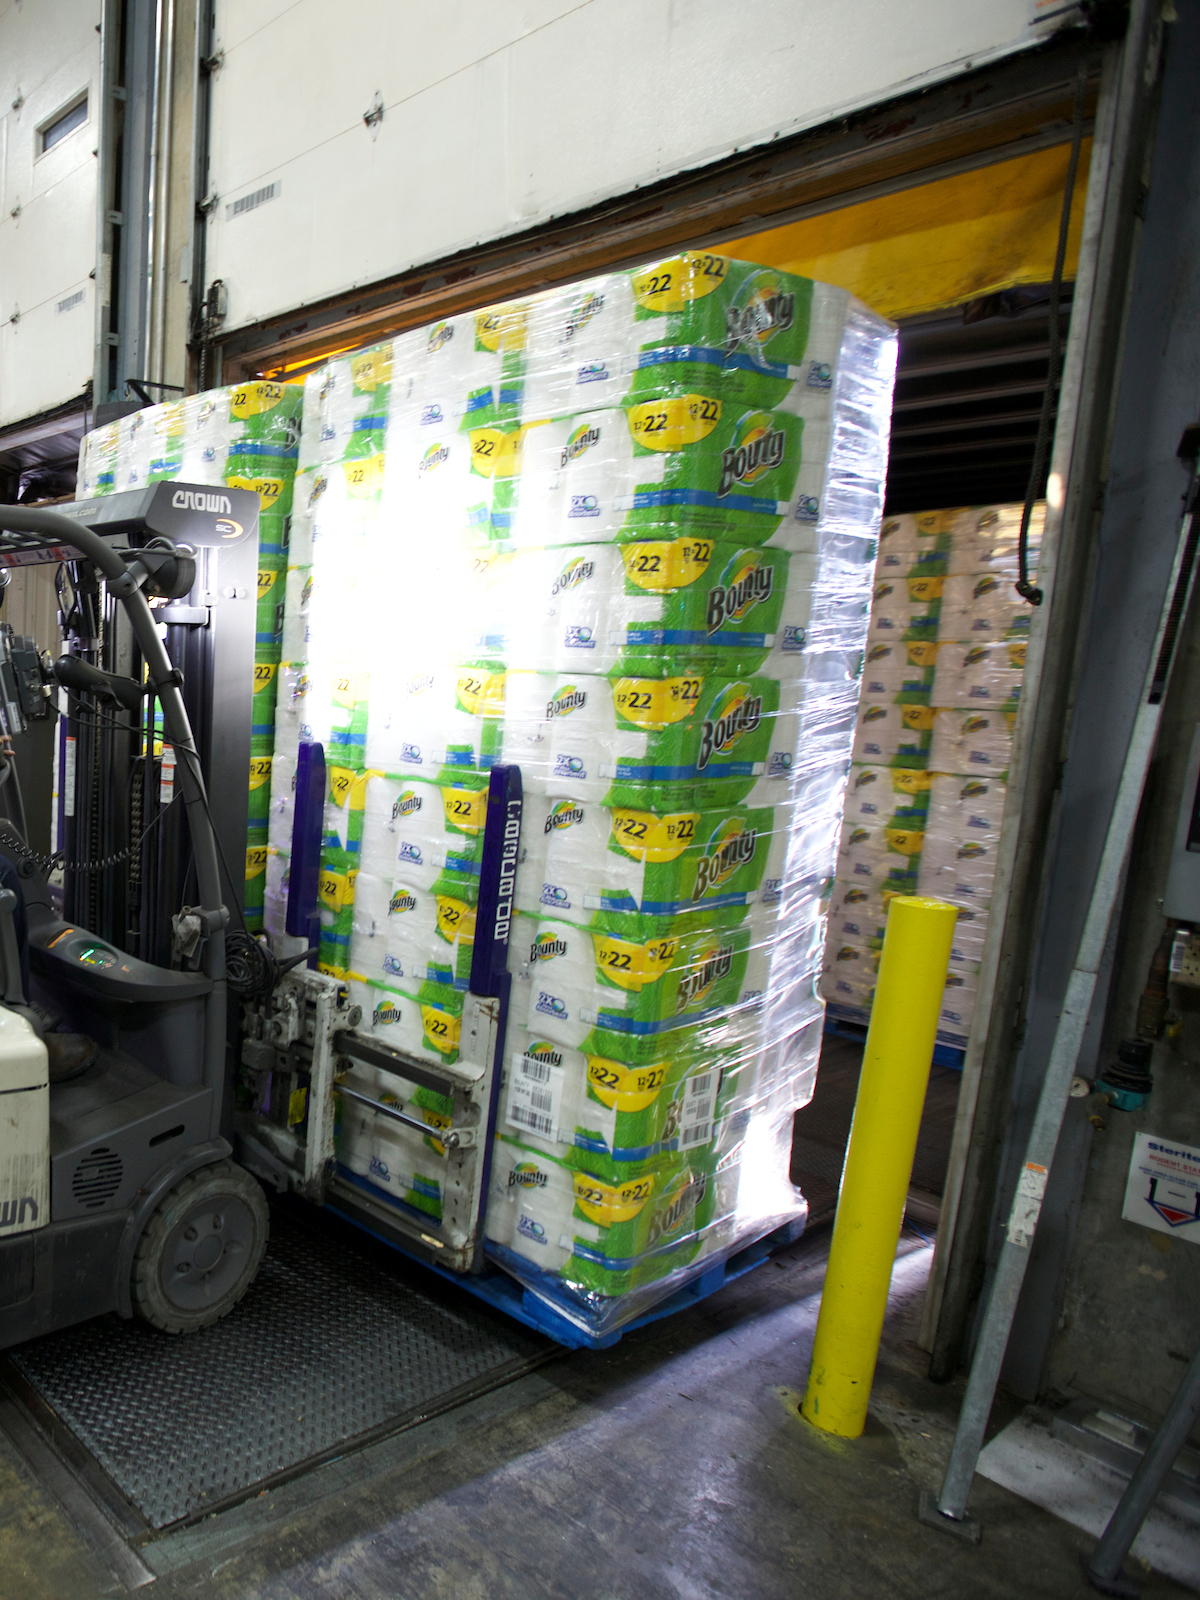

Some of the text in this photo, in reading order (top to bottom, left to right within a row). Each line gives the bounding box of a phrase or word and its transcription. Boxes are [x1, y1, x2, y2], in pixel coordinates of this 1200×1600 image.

[633, 413, 667, 433] 12=22
[717, 429, 786, 499] Bounty
[172, 490, 232, 515] CROWN
[707, 564, 775, 637] Bounty
[546, 690, 587, 722] Bounty
[697, 695, 763, 771] Bounty
[692, 827, 758, 904] Bounty
[530, 938, 567, 964] Bounty
[508, 1169, 549, 1189] Bounty
